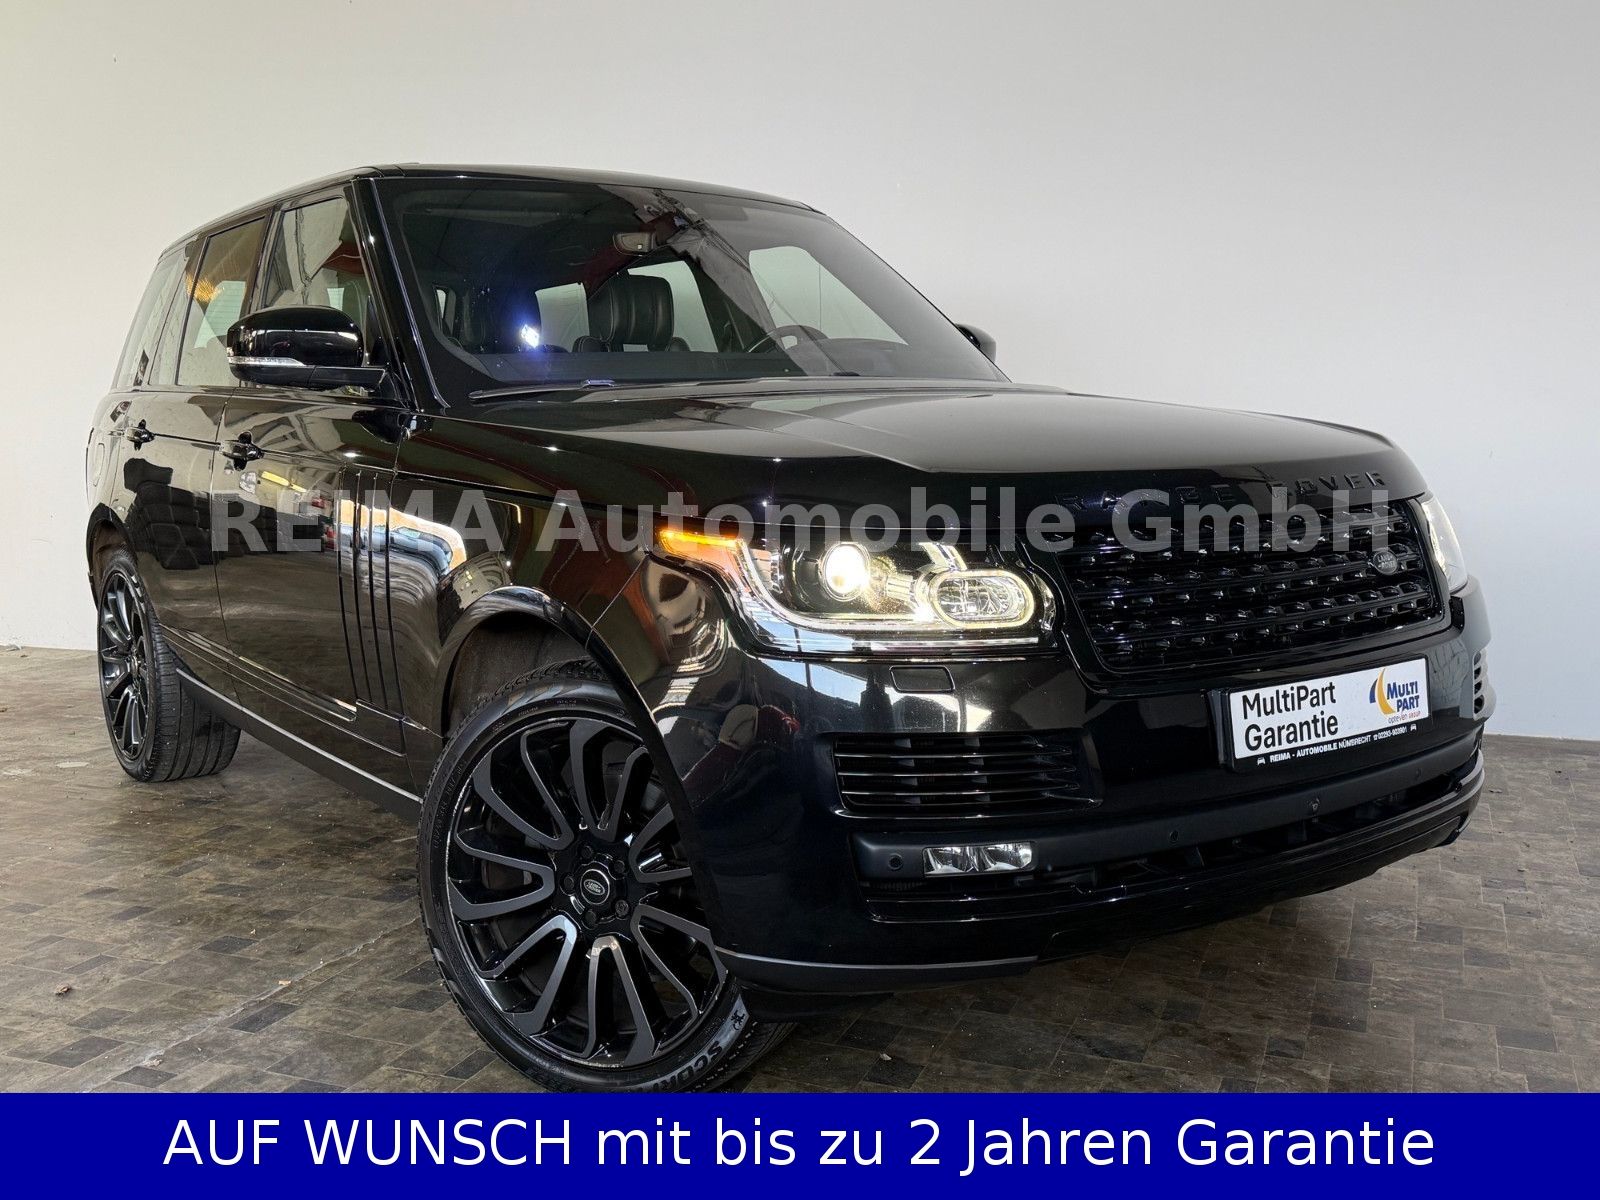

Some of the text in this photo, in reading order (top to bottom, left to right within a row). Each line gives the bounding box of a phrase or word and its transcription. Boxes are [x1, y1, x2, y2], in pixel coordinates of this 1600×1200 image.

[1242, 682, 1336, 719] MultiPart
[1396, 695, 1420, 712] PART
[1245, 710, 1338, 751] Garantie
[1269, 752, 1291, 763] REIMA
[1296, 742, 1338, 758] AUTOMOBILE
